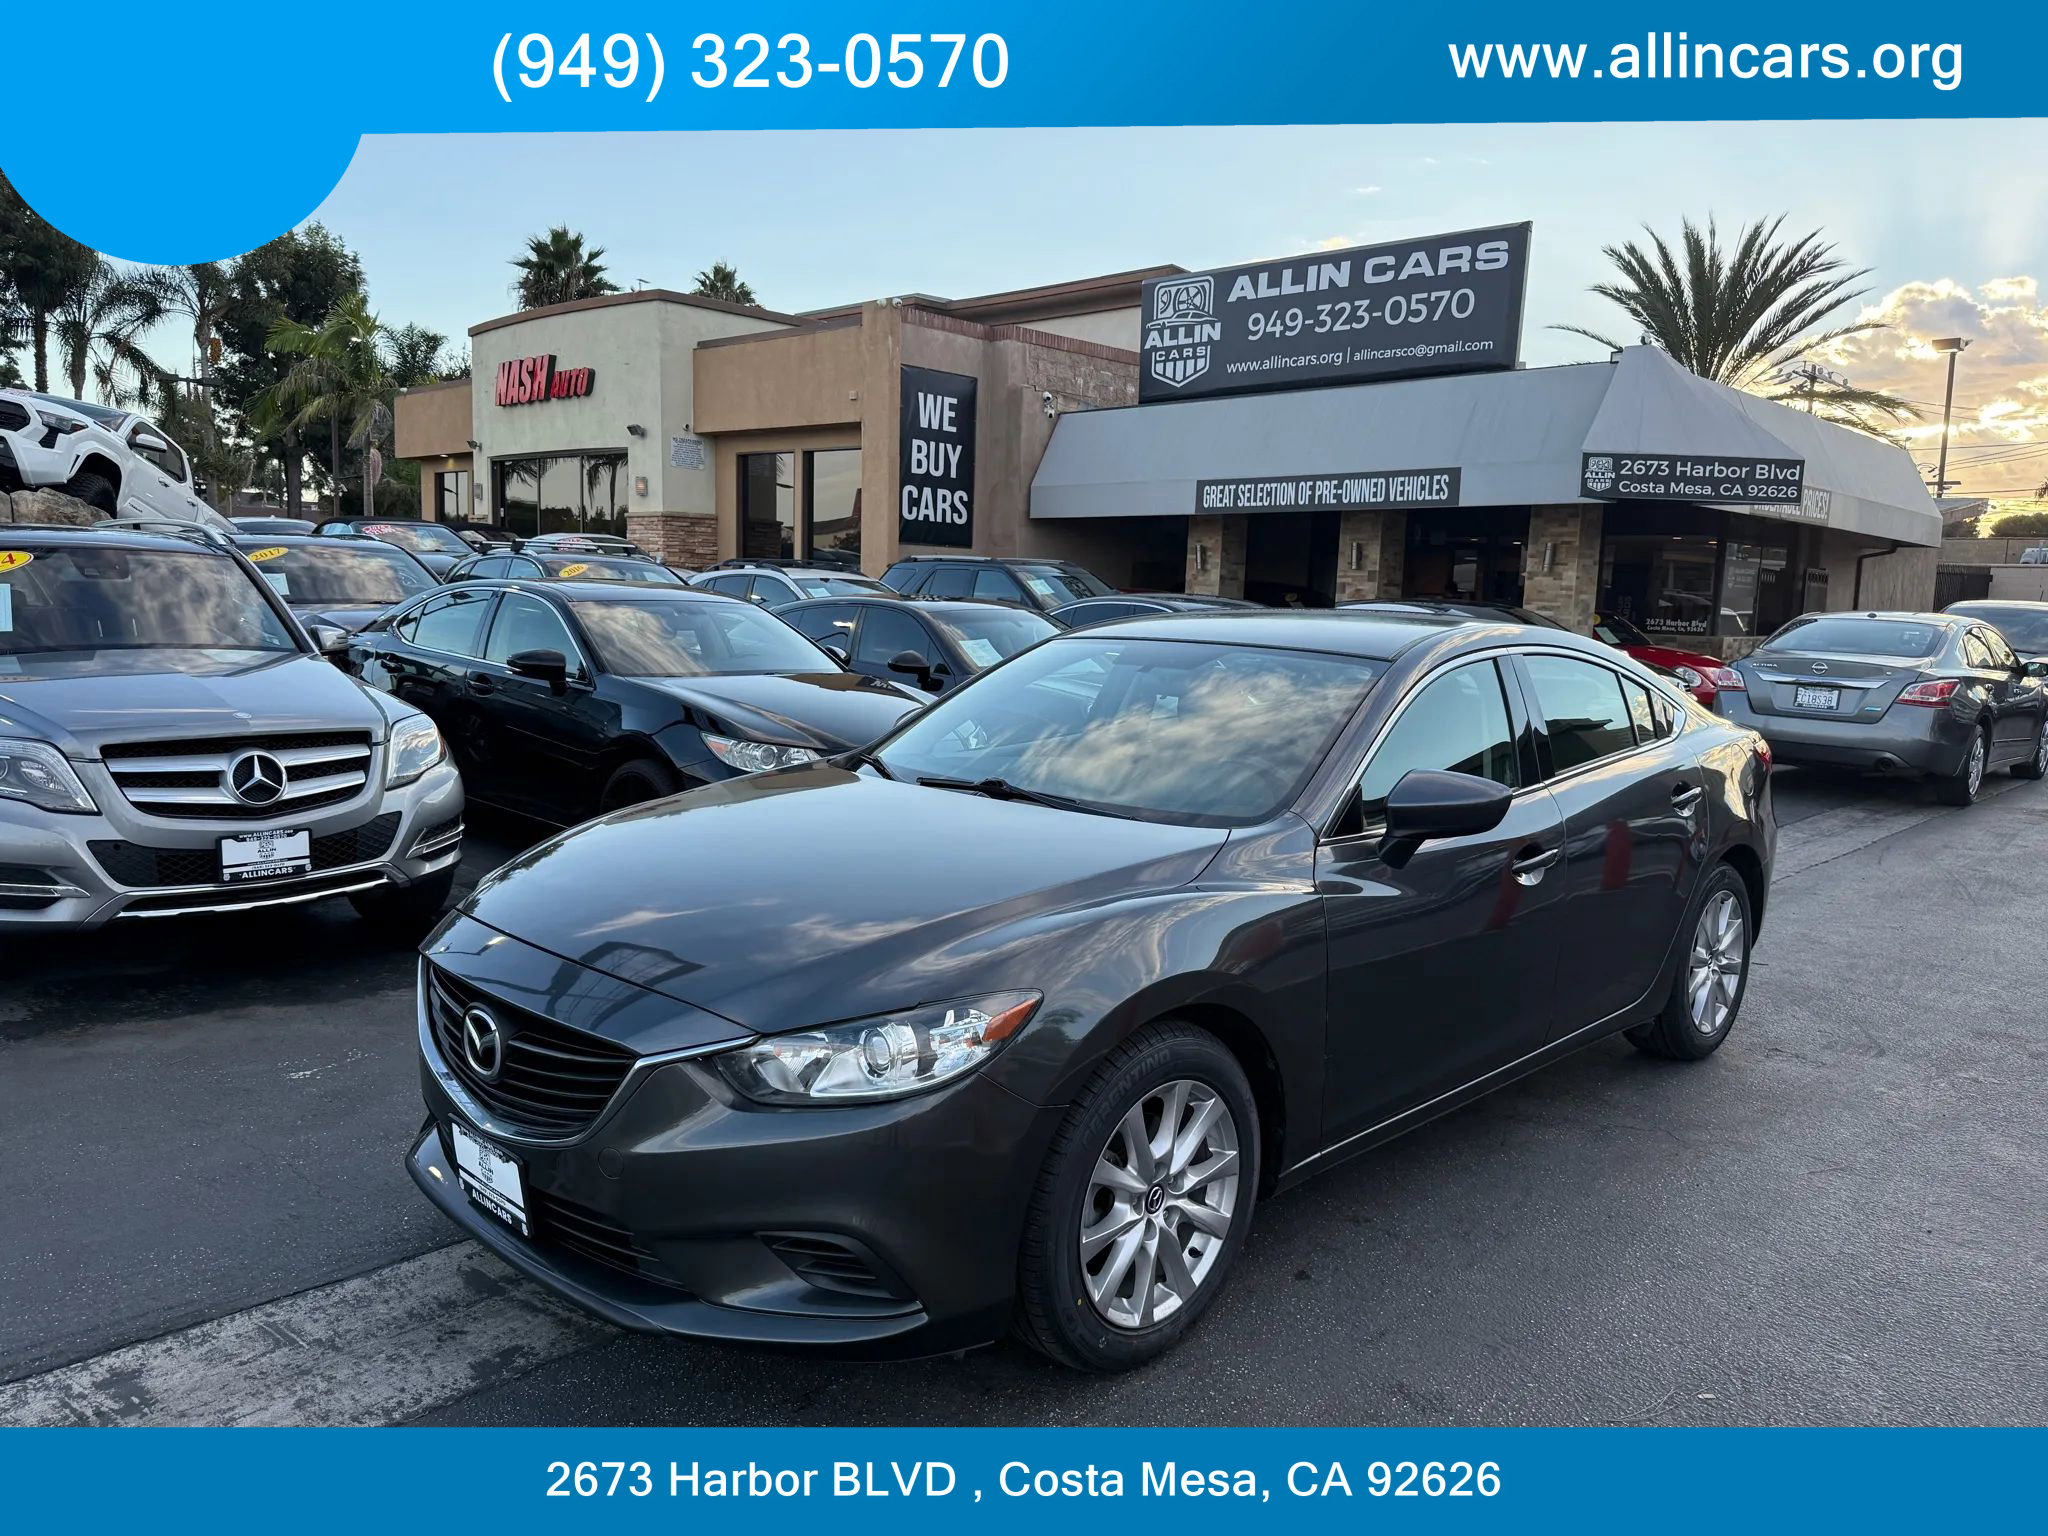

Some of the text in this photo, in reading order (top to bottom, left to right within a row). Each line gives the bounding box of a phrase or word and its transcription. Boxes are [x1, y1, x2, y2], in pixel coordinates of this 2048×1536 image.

[1227, 240, 1509, 302] ALLIN CARS
[1247, 288, 1475, 341] 949-323-0570
[1144, 322, 1221, 349] ALLIN
[1156, 346, 1206, 361] CARS
[1226, 338, 1493, 375] www.allincars.org allincarsco@gmail.com
[496, 354, 594, 407] NASH AUTO
[918, 392, 958, 433] WE
[911, 439, 962, 478] BUY
[1584, 471, 1616, 479] ALLIN
[1619, 459, 1801, 481] 2673 Harbor Blvd
[902, 485, 969, 525] CARS
[1203, 474, 1449, 508] GREAT SELECTION OF PRE-OWNED VEHICLES
[1618, 481, 1798, 498] Costa Mesa, CA 92626
[253, 548, 282, 561] 2017
[472, 1188, 512, 1225] ALLINCARS
